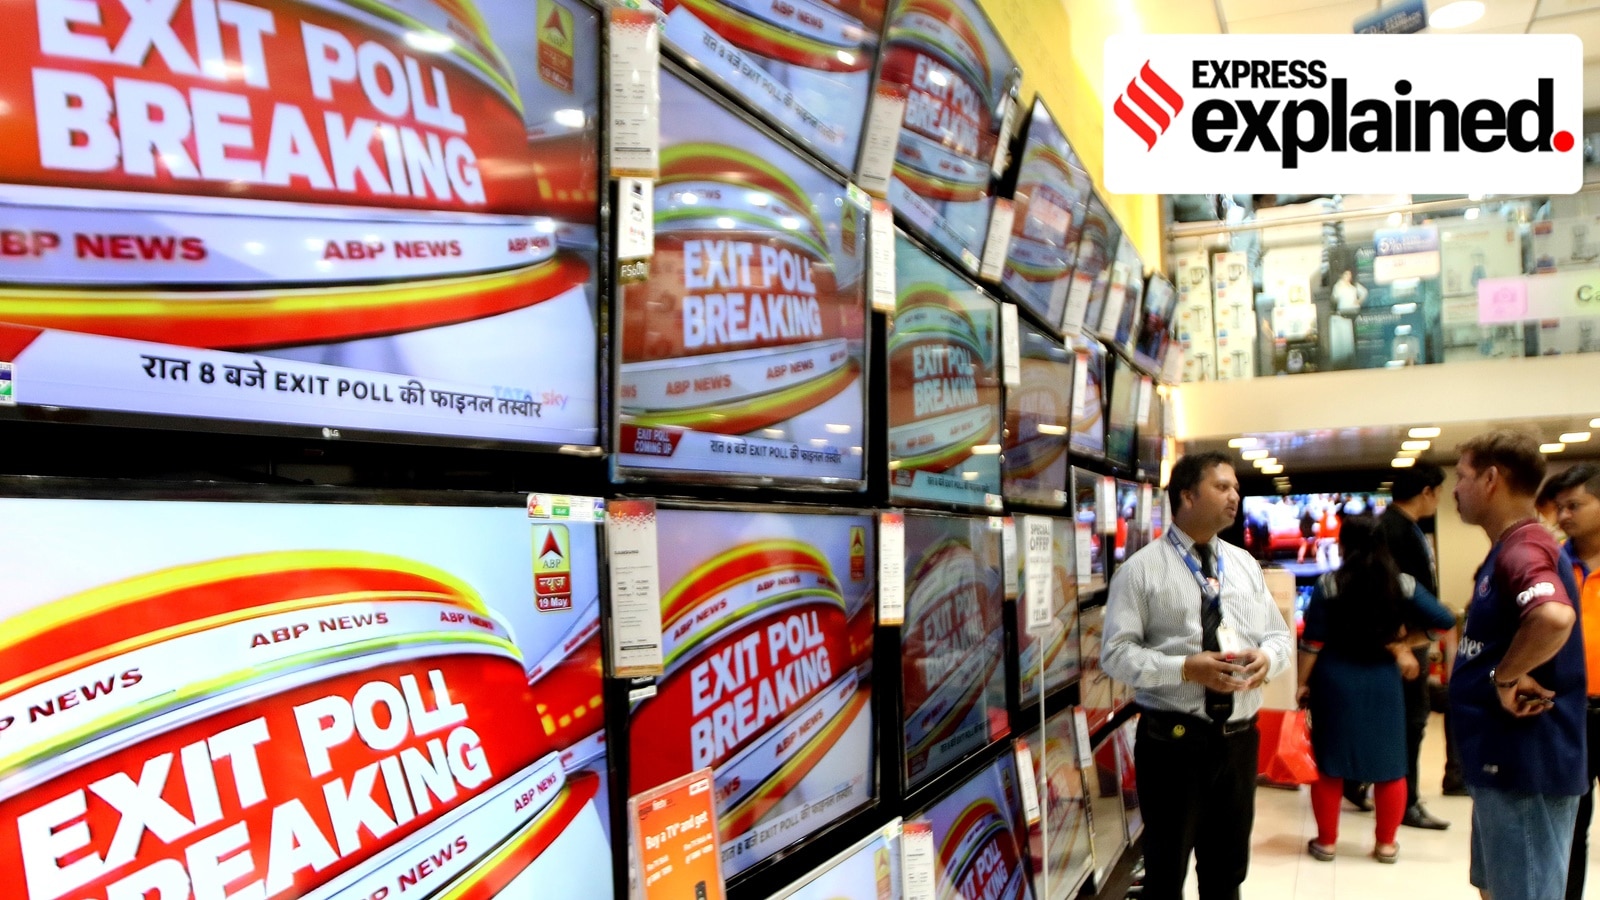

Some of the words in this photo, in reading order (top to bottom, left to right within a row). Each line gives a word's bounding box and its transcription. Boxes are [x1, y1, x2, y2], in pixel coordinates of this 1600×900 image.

[35, 0, 277, 89] EXIT
[300, 19, 468, 134] POLL
[31, 67, 486, 204] BREAKING
[74, 232, 208, 263] NEWS
[323, 240, 384, 261] ABP
[393, 240, 462, 259] NEWS
[683, 240, 753, 290] EXIT
[762, 246, 816, 294] POLL
[682, 292, 822, 348] BREAKING
[766, 366, 787, 381] ABP
[790, 359, 815, 374] NEWS
[913, 343, 944, 379] EXIT
[947, 346, 975, 379] POLL
[140, 354, 191, 382] रात
[199, 362, 216, 384] 8
[223, 360, 266, 390] बजे
[275, 372, 329, 396] EXIT
[337, 379, 394, 402] POLL
[399, 380, 425, 406] की
[429, 387, 493, 414] फाइनल
[665, 381, 691, 396] ABP
[693, 374, 732, 393] NEWS
[913, 376, 978, 417] BREAKING
[749, 444, 767, 457] EXIT
[769, 446, 789, 459] POLL
[1030, 536, 1050, 550] OFFER
[542, 558, 561, 569] ABP
[538, 598, 549, 608] 19
[551, 597, 568, 609] May
[756, 579, 775, 592] ABP
[249, 622, 310, 648] ABP
[320, 611, 389, 633] NEWS
[440, 610, 465, 624] ABP
[468, 613, 494, 630] NEWS
[673, 618, 693, 641] ABP
[696, 598, 727, 623] NEWS
[690, 632, 760, 717] EXIT
[768, 611, 825, 666] POLL
[28, 667, 143, 723] NEWS
[690, 646, 832, 773] BREAKING
[775, 731, 796, 757] ABP
[799, 708, 824, 738] NEWS
[17, 716, 271, 900] EXIT
[293, 669, 468, 777] POLL
[514, 792, 535, 812] ABP
[537, 773, 557, 794] NEWS
[645, 835, 660, 850] Buy
[660, 831, 667, 842] a
[680, 815, 694, 833] and
[695, 810, 708, 829] get
[760, 826, 777, 844] EXIT
[780, 815, 799, 832] POLL
[397, 835, 468, 893] NEWS
[976, 838, 1002, 885] POLL
